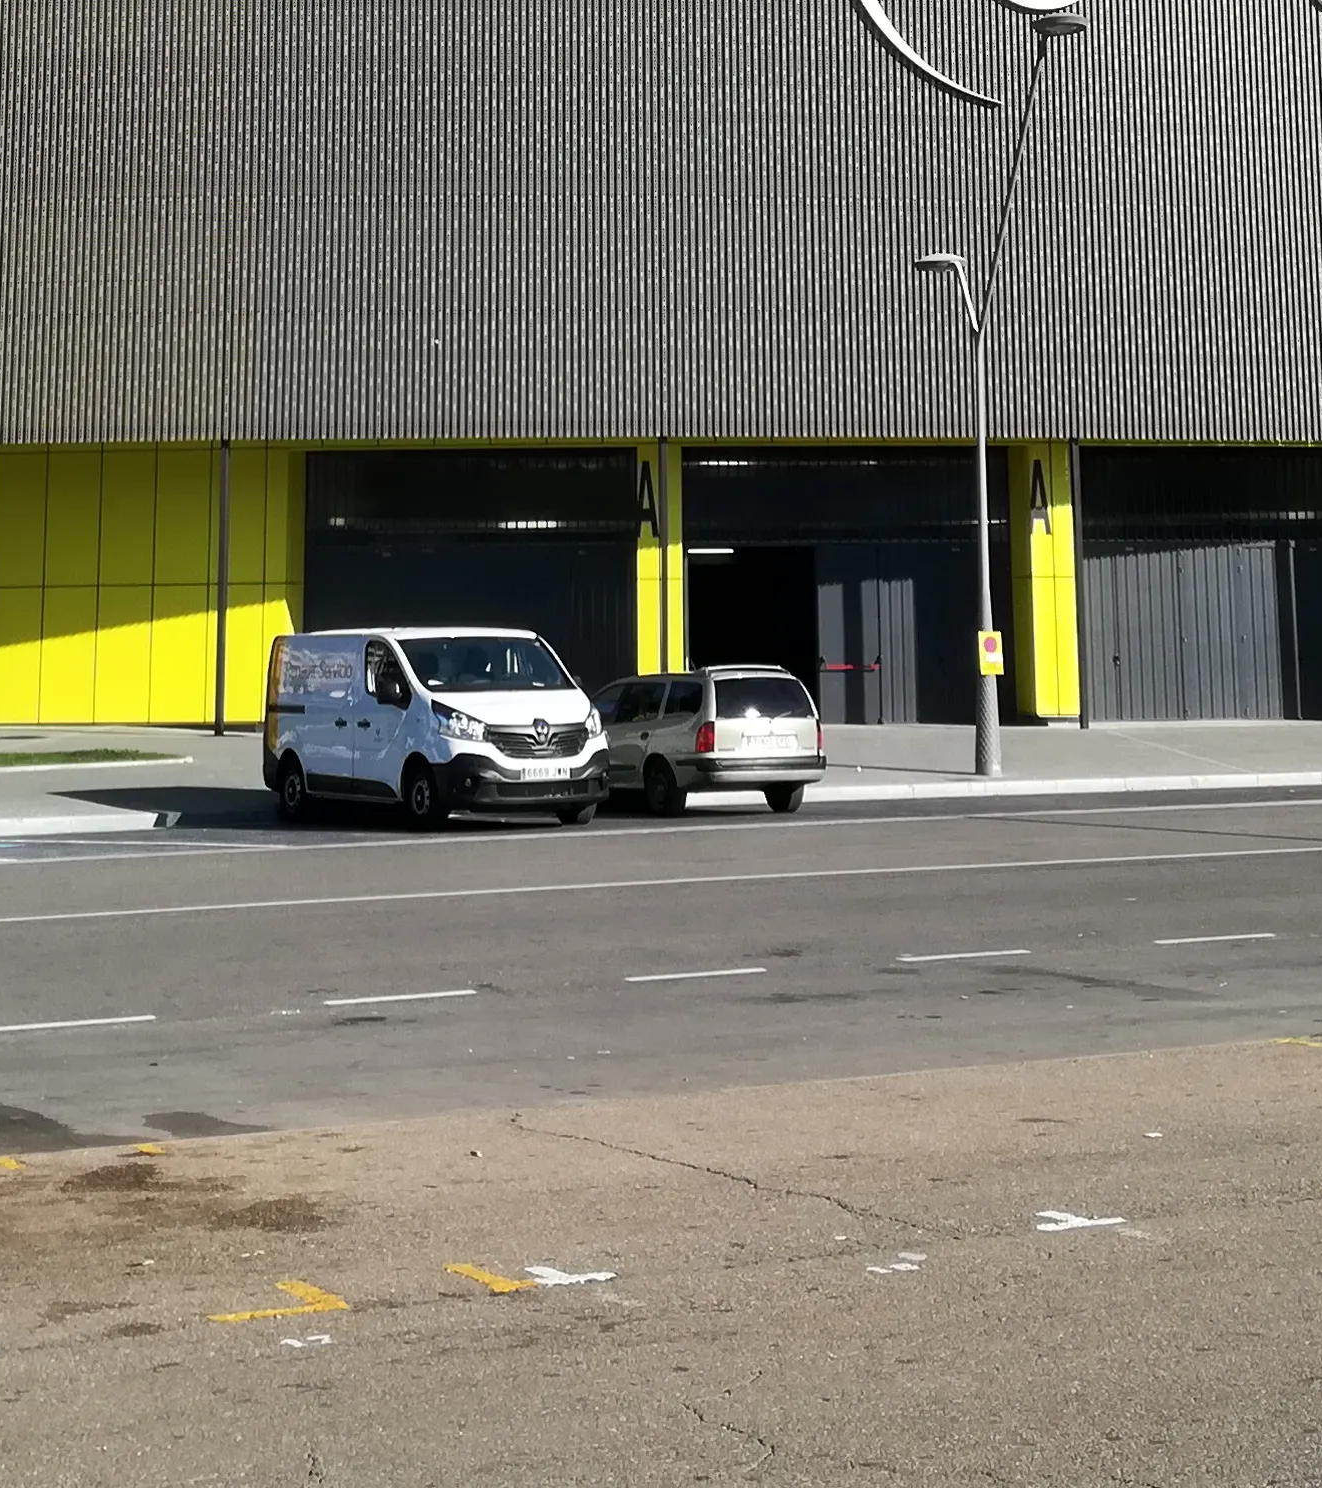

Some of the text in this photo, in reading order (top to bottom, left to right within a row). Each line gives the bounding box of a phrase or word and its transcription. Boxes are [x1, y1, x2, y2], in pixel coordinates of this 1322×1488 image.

[635, 460, 659, 538] A
[1030, 458, 1052, 535] A
[527, 768, 550, 778] 6669
